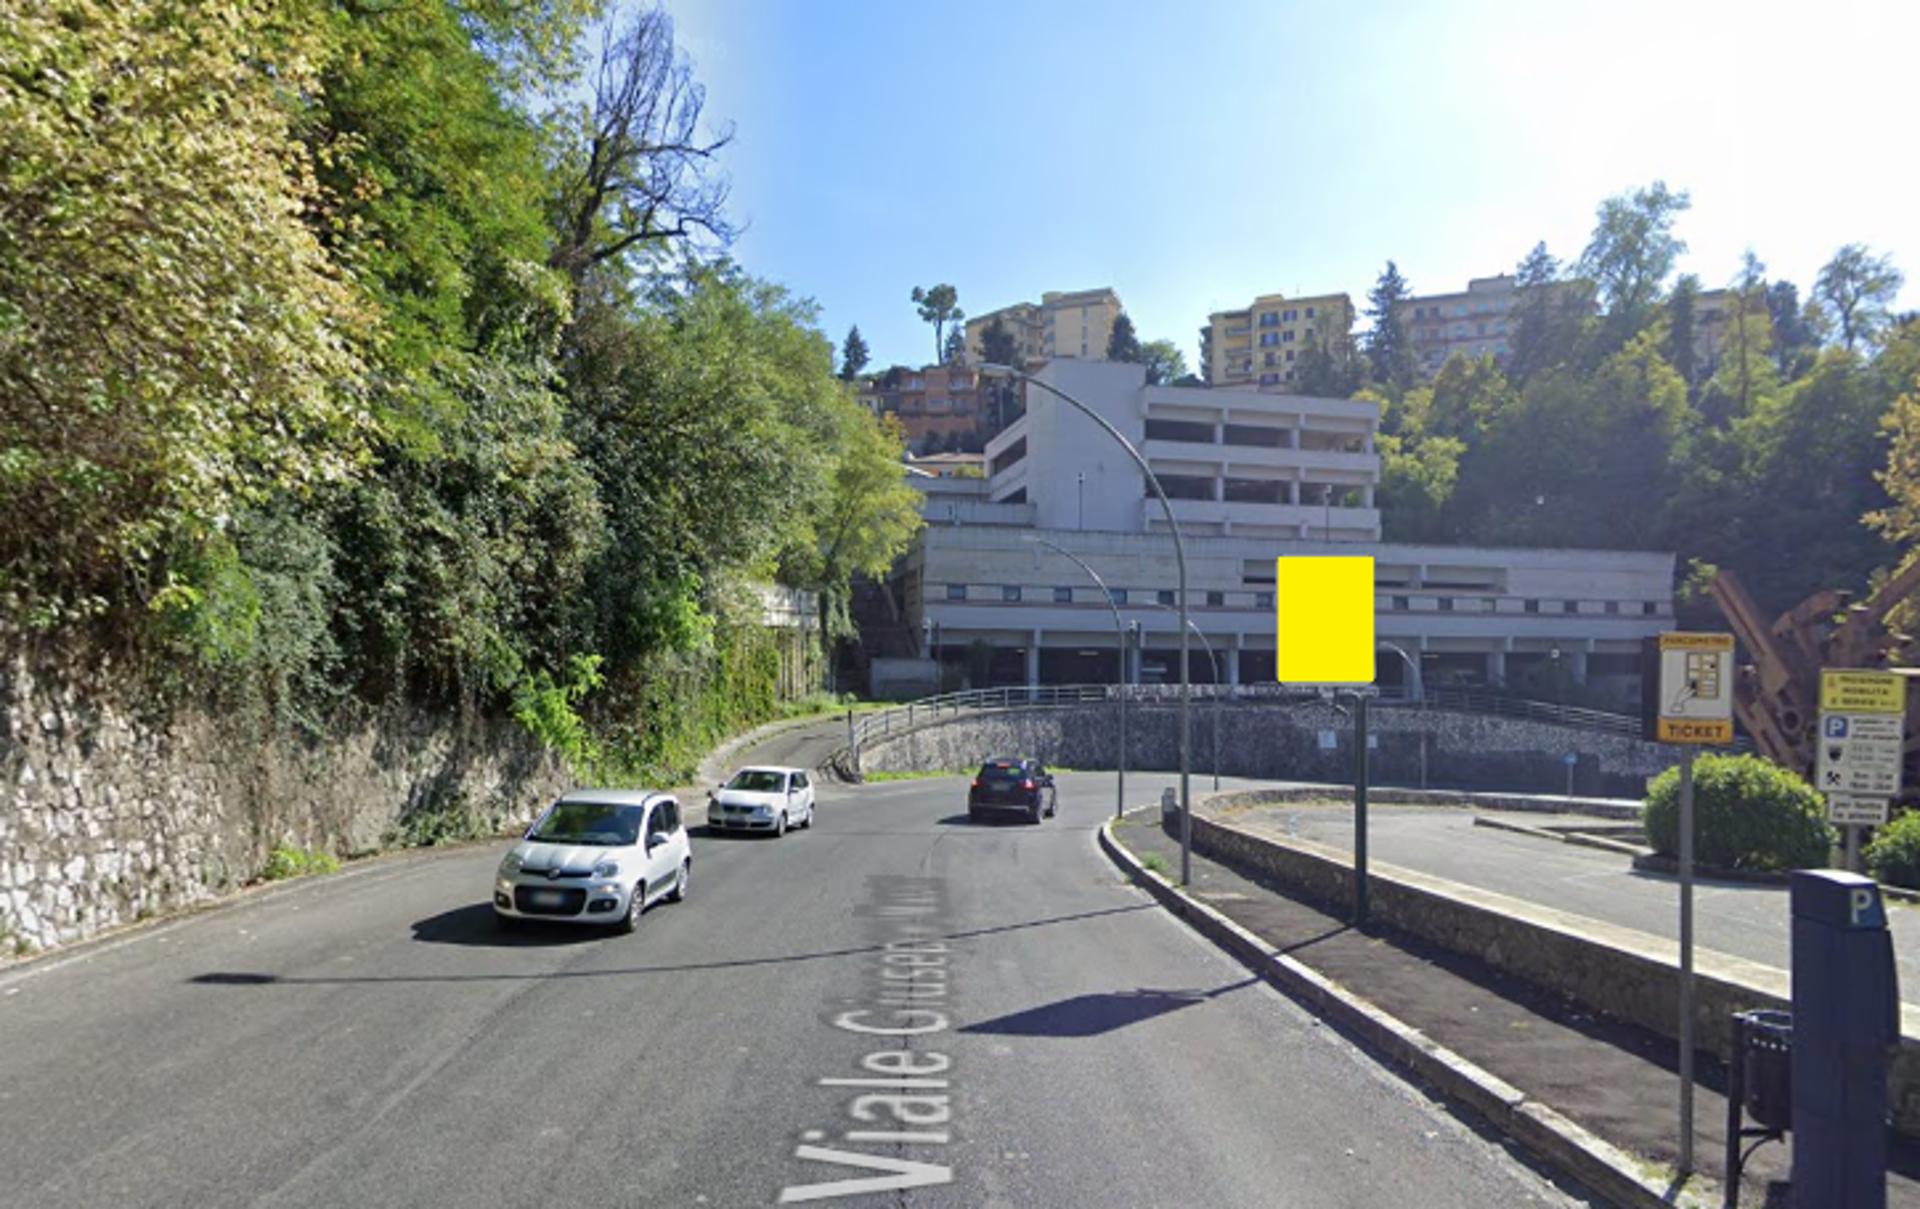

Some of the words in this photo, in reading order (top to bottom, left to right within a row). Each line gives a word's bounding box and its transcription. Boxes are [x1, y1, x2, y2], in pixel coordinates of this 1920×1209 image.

[1667, 723, 1724, 738] TICKET
[1829, 717, 1845, 736] P
[1851, 888, 1872, 923] P
